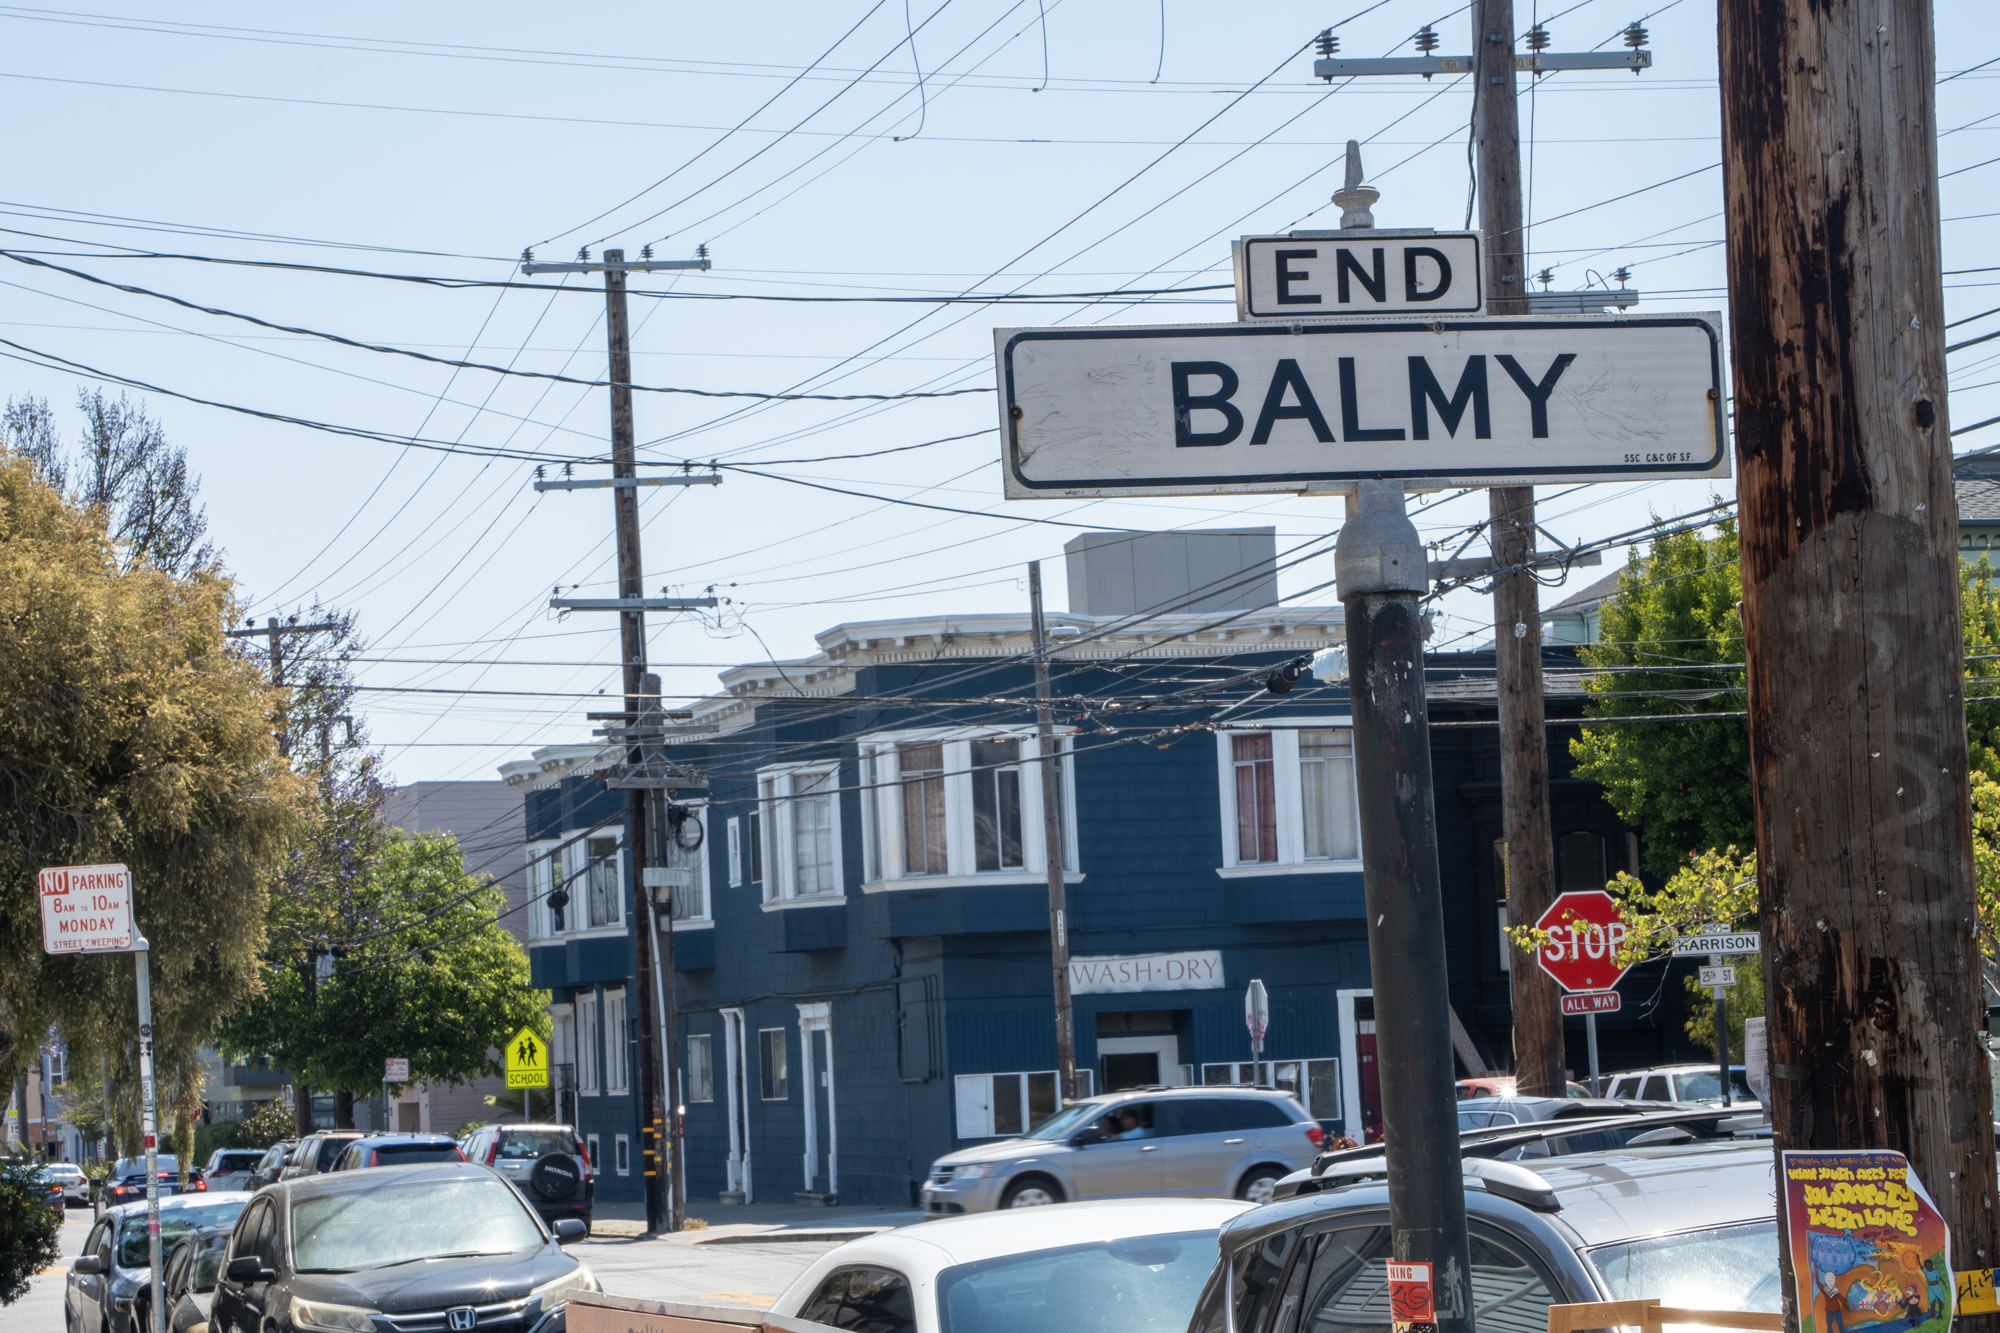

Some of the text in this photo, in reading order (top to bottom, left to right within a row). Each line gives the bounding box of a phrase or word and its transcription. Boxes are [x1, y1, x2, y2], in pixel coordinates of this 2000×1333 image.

[1275, 247, 1452, 305] END
[1171, 353, 1577, 448] BALMY
[1624, 452, 1694, 463] SSC C&C OF S.F.
[43, 872, 124, 893] NO PARKING
[53, 898, 75, 913] 8AM
[92, 895, 119, 911] 10AM
[59, 917, 115, 933] MONDAY
[53, 936, 124, 949] STREET SWEEPING
[1545, 922, 1628, 962] STOP
[1678, 937, 1756, 952] HARRISON
[1702, 970, 1731, 982] 25TH ST
[1567, 996, 1615, 1011] ALL WAY
[509, 1072, 546, 1085] SCHOOL
[544, 1165, 574, 1178] HONDA
